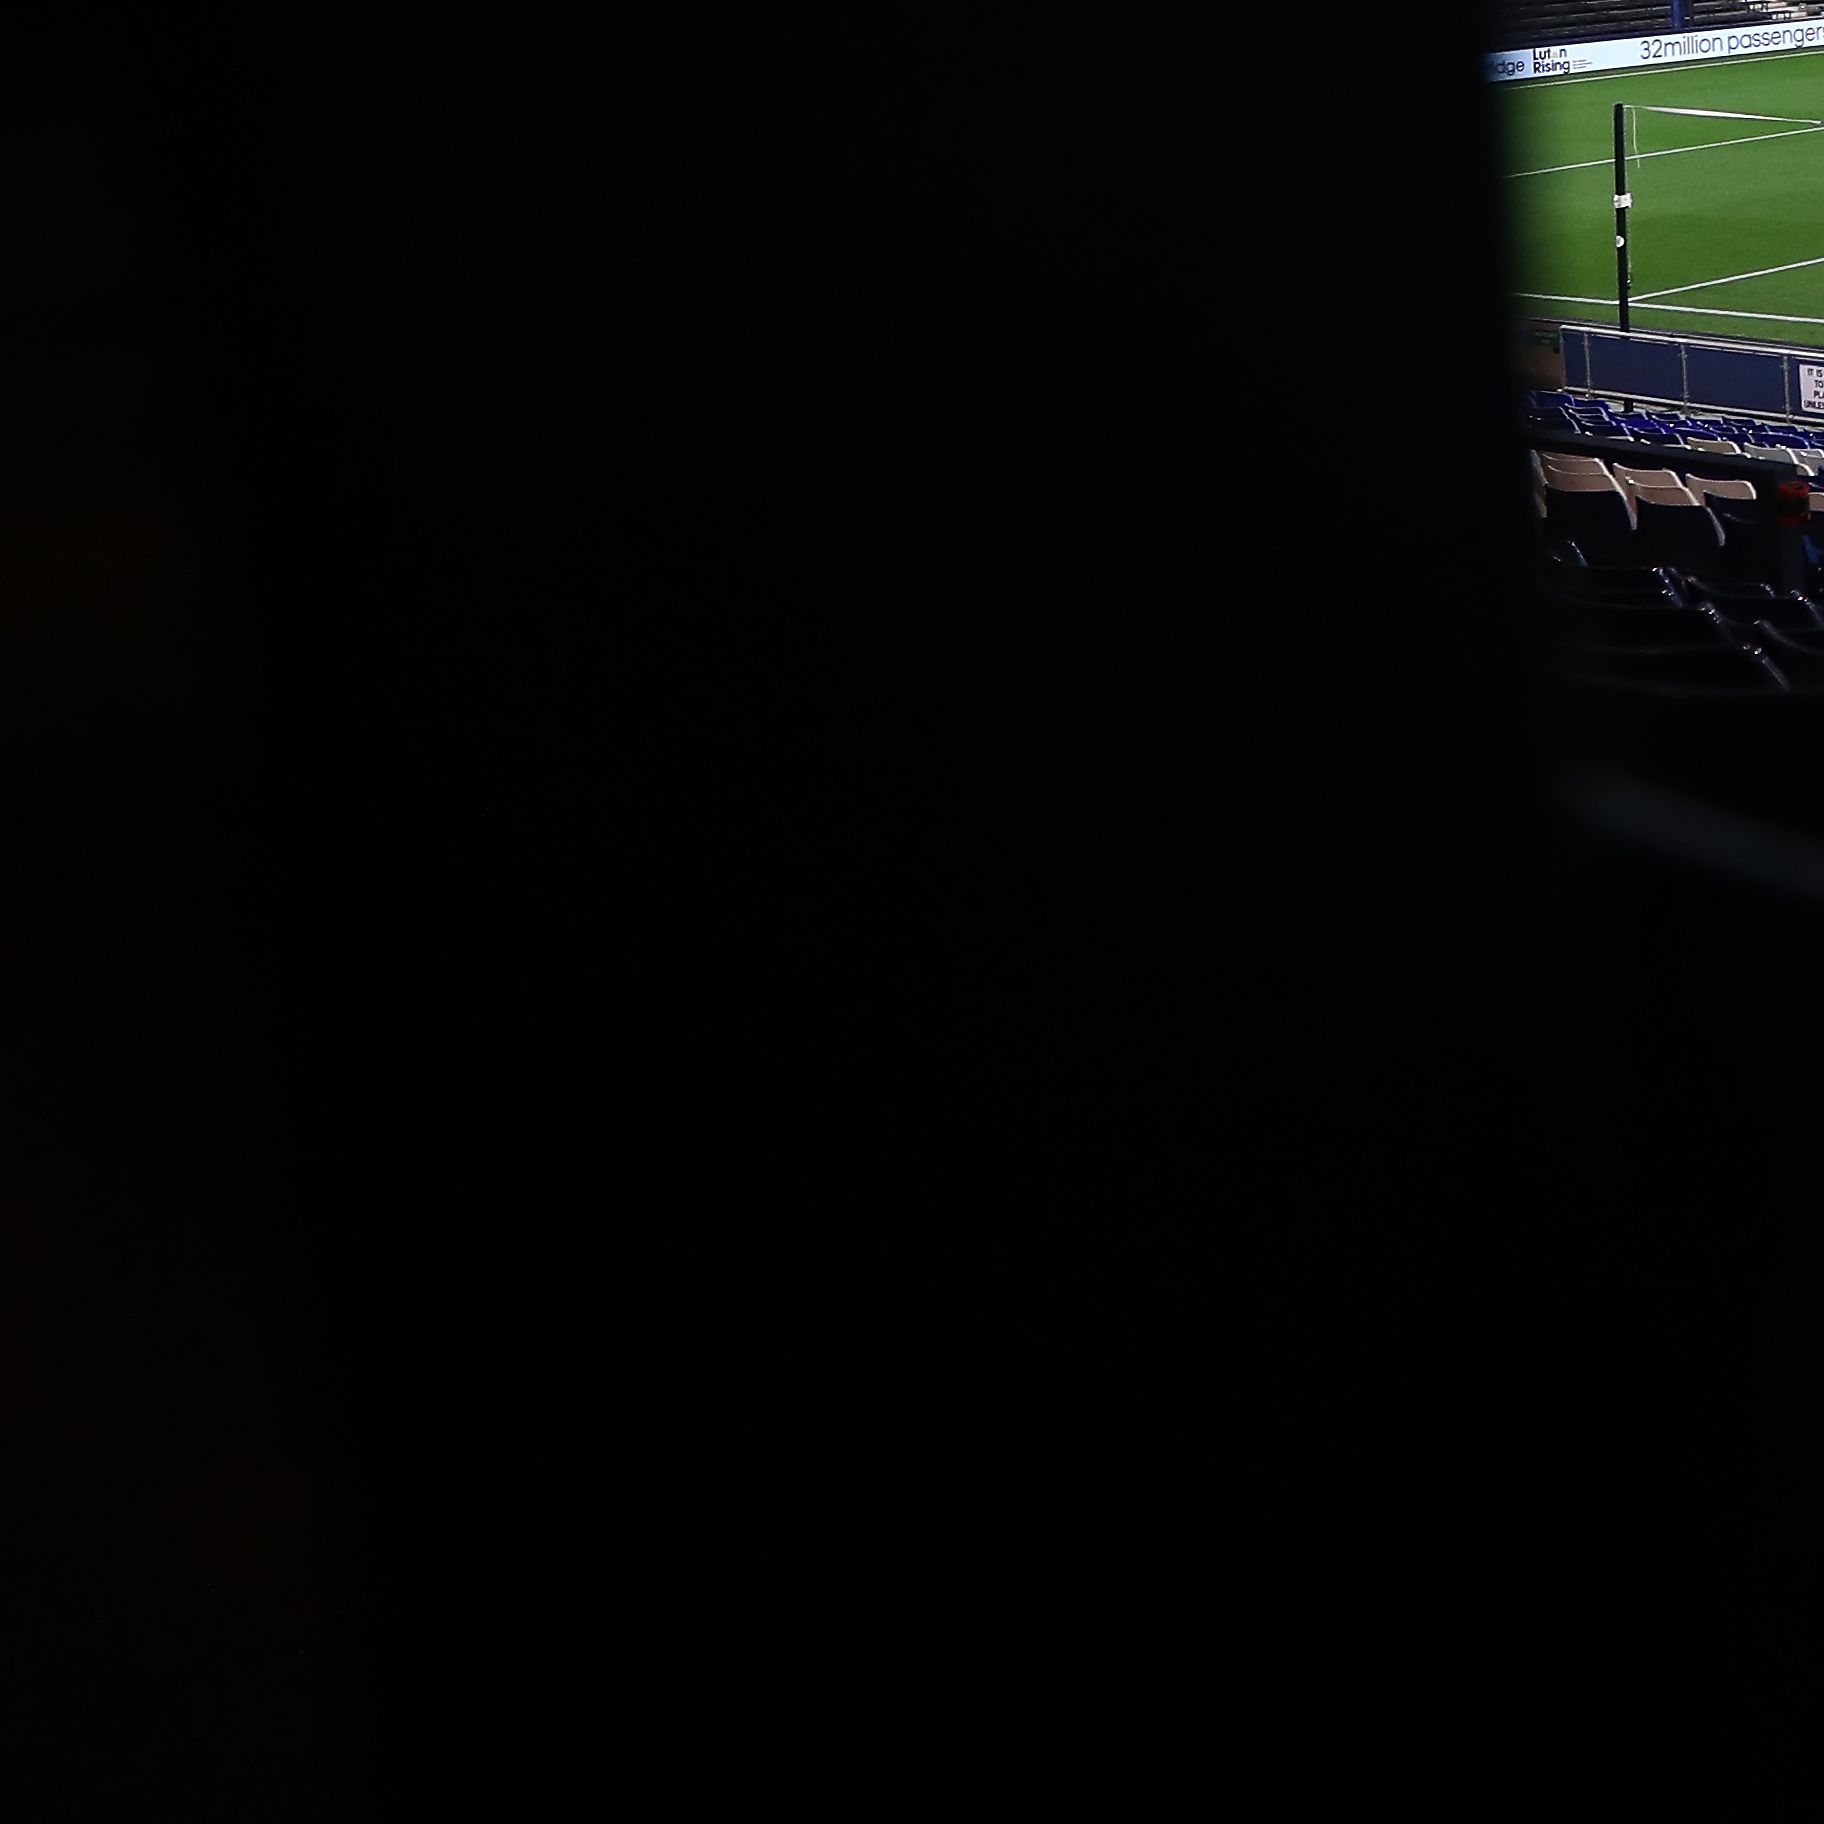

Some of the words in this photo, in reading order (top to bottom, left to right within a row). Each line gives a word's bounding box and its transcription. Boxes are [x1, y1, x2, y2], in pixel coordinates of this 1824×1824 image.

[1640, 35, 1723, 60] 32million
[1533, 59, 1570, 74] Rising
[1807, 368, 1814, 376] IT
[1816, 369, 1823, 378] IS
[1814, 379, 1824, 388] TO
